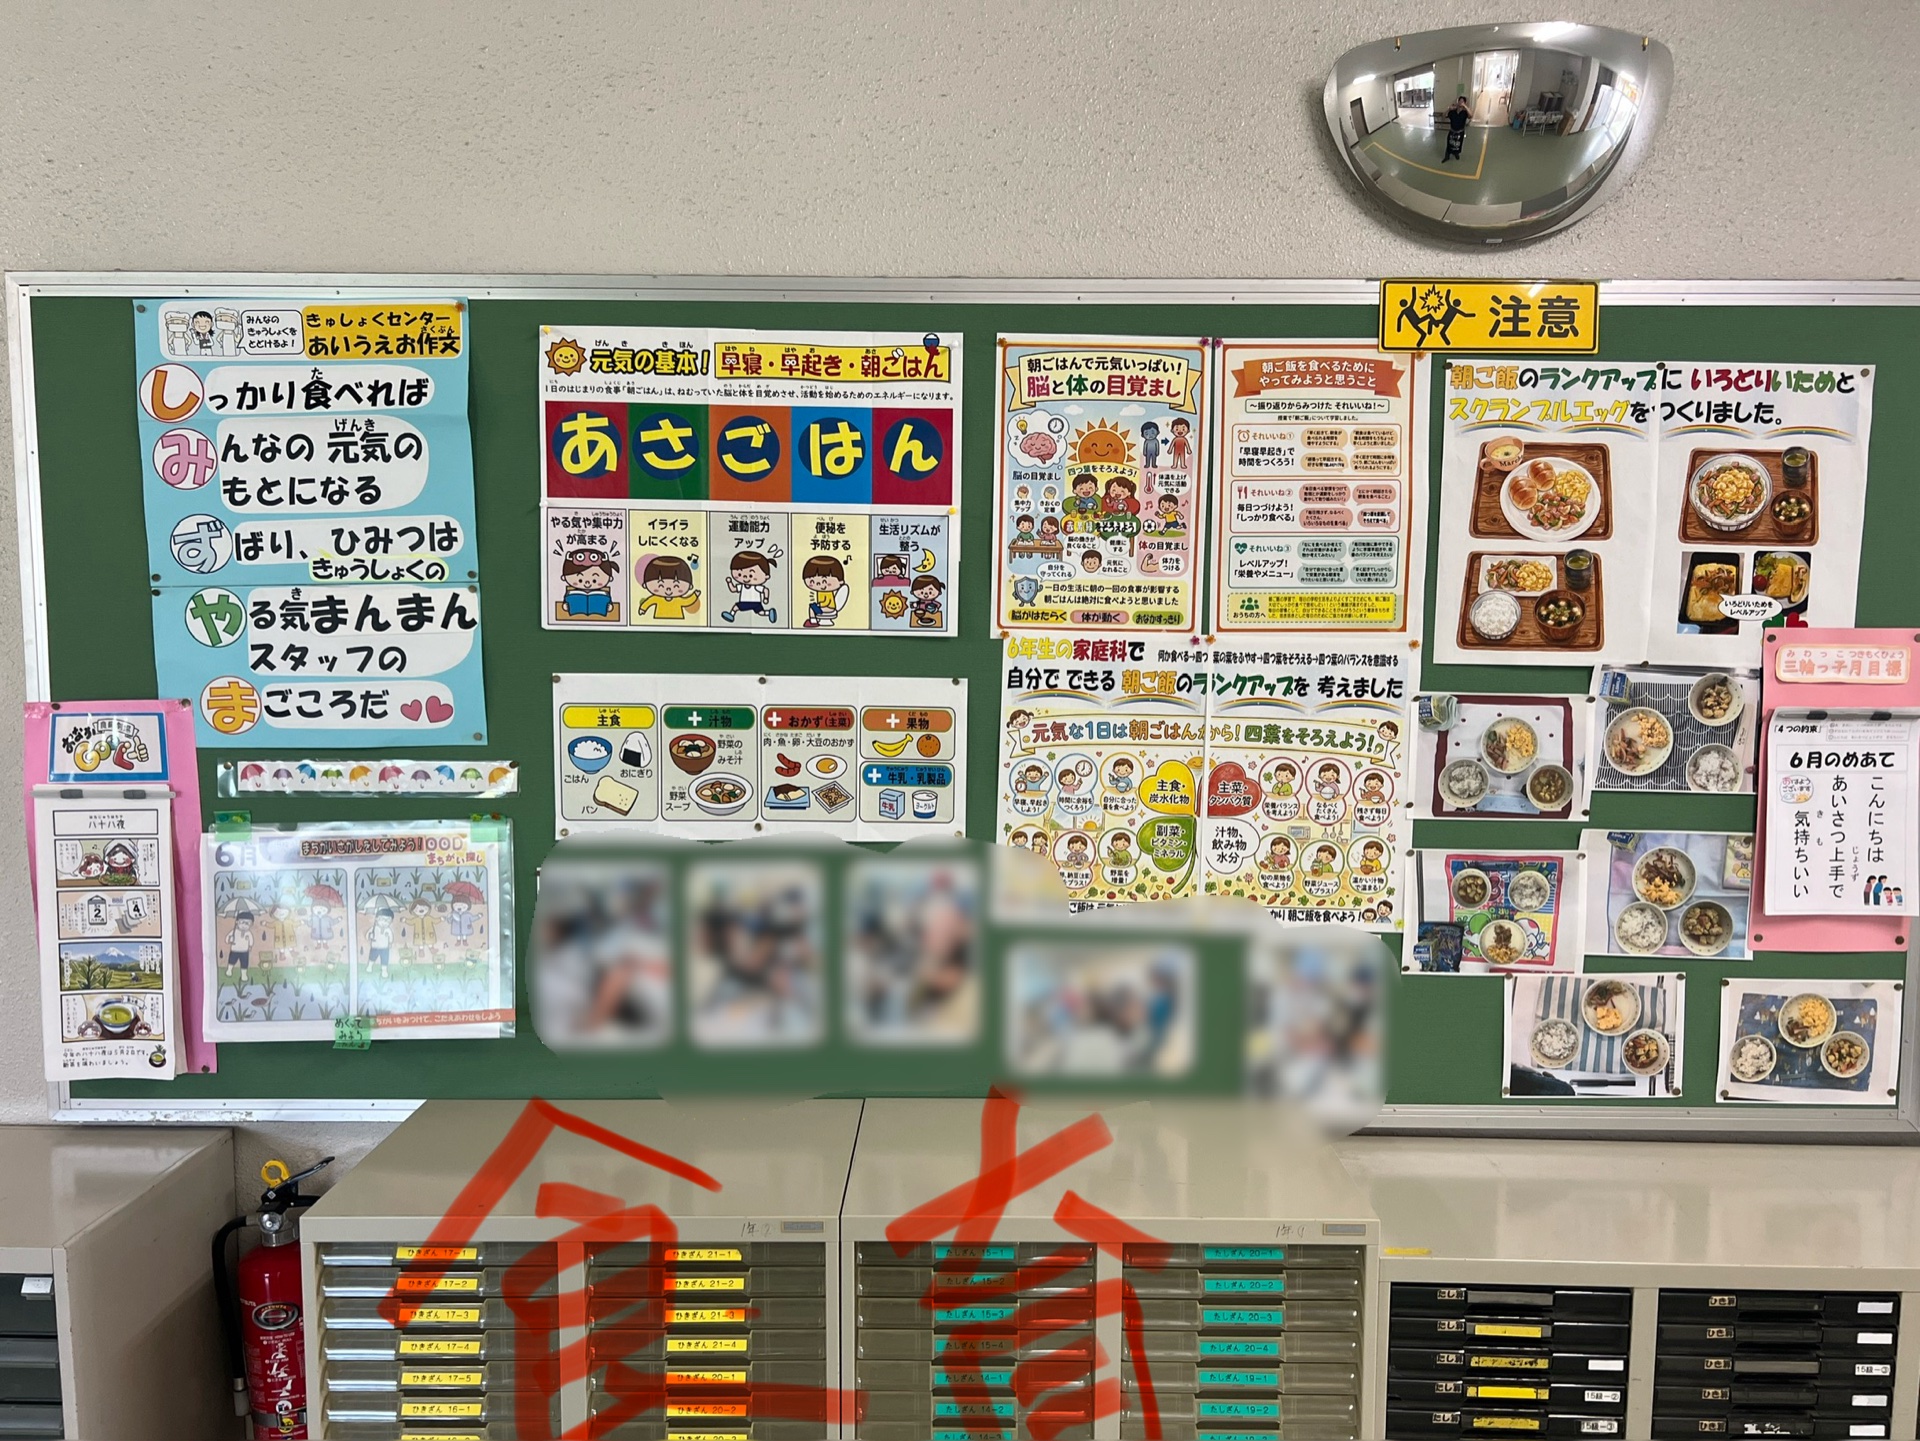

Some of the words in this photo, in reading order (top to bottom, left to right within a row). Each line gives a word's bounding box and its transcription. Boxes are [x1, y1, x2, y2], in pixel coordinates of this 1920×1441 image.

[246, 315, 280, 324] みんなの
[306, 311, 451, 328] きゅしょくセンター
[1489, 295, 1580, 338] 注意
[247, 326, 298, 336] きゅうしょくを
[308, 334, 461, 356] あいうえお作文
[590, 347, 711, 376] 元気の基本！
[1261, 360, 1375, 374] 朝ご飯を食べるために
[310, 367, 324, 380] た
[1027, 374, 1181, 398] 脳と体の目覚まし
[1259, 374, 1376, 387] やってみようと思うこと
[1691, 368, 1855, 394] いろどりいためと
[334, 418, 376, 431] げんき
[1239, 447, 1295, 456] 「早寝早起き」で
[1012, 471, 1061, 481] 脳の目覚まし
[221, 475, 382, 507] もとになる
[551, 517, 623, 529] やる気や集中力
[1236, 513, 1295, 523] 「しっかり食べる」
[648, 519, 689, 530] イライラ
[728, 520, 770, 533] 運動能力
[815, 522, 846, 534] 便秘を
[879, 524, 941, 536] 生活リズムが
[566, 534, 608, 546] が高まる
[638, 536, 699, 547] しにくくなる
[734, 538, 766, 549] アップ
[810, 540, 851, 551] 予防する
[899, 541, 920, 552] 整う
[1138, 541, 1189, 551] 体の目覚まし
[311, 558, 446, 581] きゅうしょくの
[1234, 569, 1294, 579] 「栄養やメニュー」
[291, 587, 302, 600] き
[1725, 601, 1773, 609] いろどりいためを
[1011, 610, 1067, 621] 脳がはたらく
[1081, 612, 1120, 623] 体が動く
[1136, 614, 1180, 625] おなかすっきり
[1233, 611, 1266, 619] おうちの方へ
[1007, 637, 1145, 663] 6年生の家庭科で
[1787, 650, 1796, 658] み
[1804, 650, 1812, 658] わ
[249, 643, 407, 673] スタッフの
[1783, 660, 1902, 677] 三輪っ子月目標
[1317, 676, 1403, 699] 考えました
[597, 714, 621, 727] 主食
[708, 715, 732, 728] 汁物
[906, 717, 930, 730] 果物
[717, 739, 743, 749] 野菜の
[717, 755, 743, 765] みそ汁
[1790, 751, 1895, 769] 6月のめあて
[564, 774, 590, 784] ごはん
[620, 769, 653, 778] おにぎり
[1782, 777, 1811, 786] おはよう
[669, 791, 687, 801] 野菜
[1149, 793, 1190, 805] 炭水化物
[1209, 795, 1252, 807] タンパク質
[581, 805, 598, 815] パン
[665, 802, 691, 811] スープ
[882, 801, 895, 812] 牛乳
[1816, 810, 1824, 818] き
[1868, 776, 1885, 863] こんにちは
[88, 819, 126, 830] 八十八夜
[1816, 837, 1824, 846] も
[1829, 775, 1847, 898] あいさつ上手で
[1212, 839, 1247, 851] 飲み物
[1153, 849, 1184, 859] ミネラル
[1216, 852, 1240, 864] 水分
[1794, 810, 1810, 898] 気持ちいい
[1851, 846, 1859, 882] じょうず
[675, 1280, 705, 1288] ひきざん
[410, 1311, 440, 1319] ひきざん
[946, 1310, 976, 1318] たしざん
[1214, 1312, 1244, 1321] たしざん
[411, 1343, 441, 1351] ひきざん
[678, 1341, 708, 1349] ひきざん
[1210, 1344, 1240, 1352] たしざん
